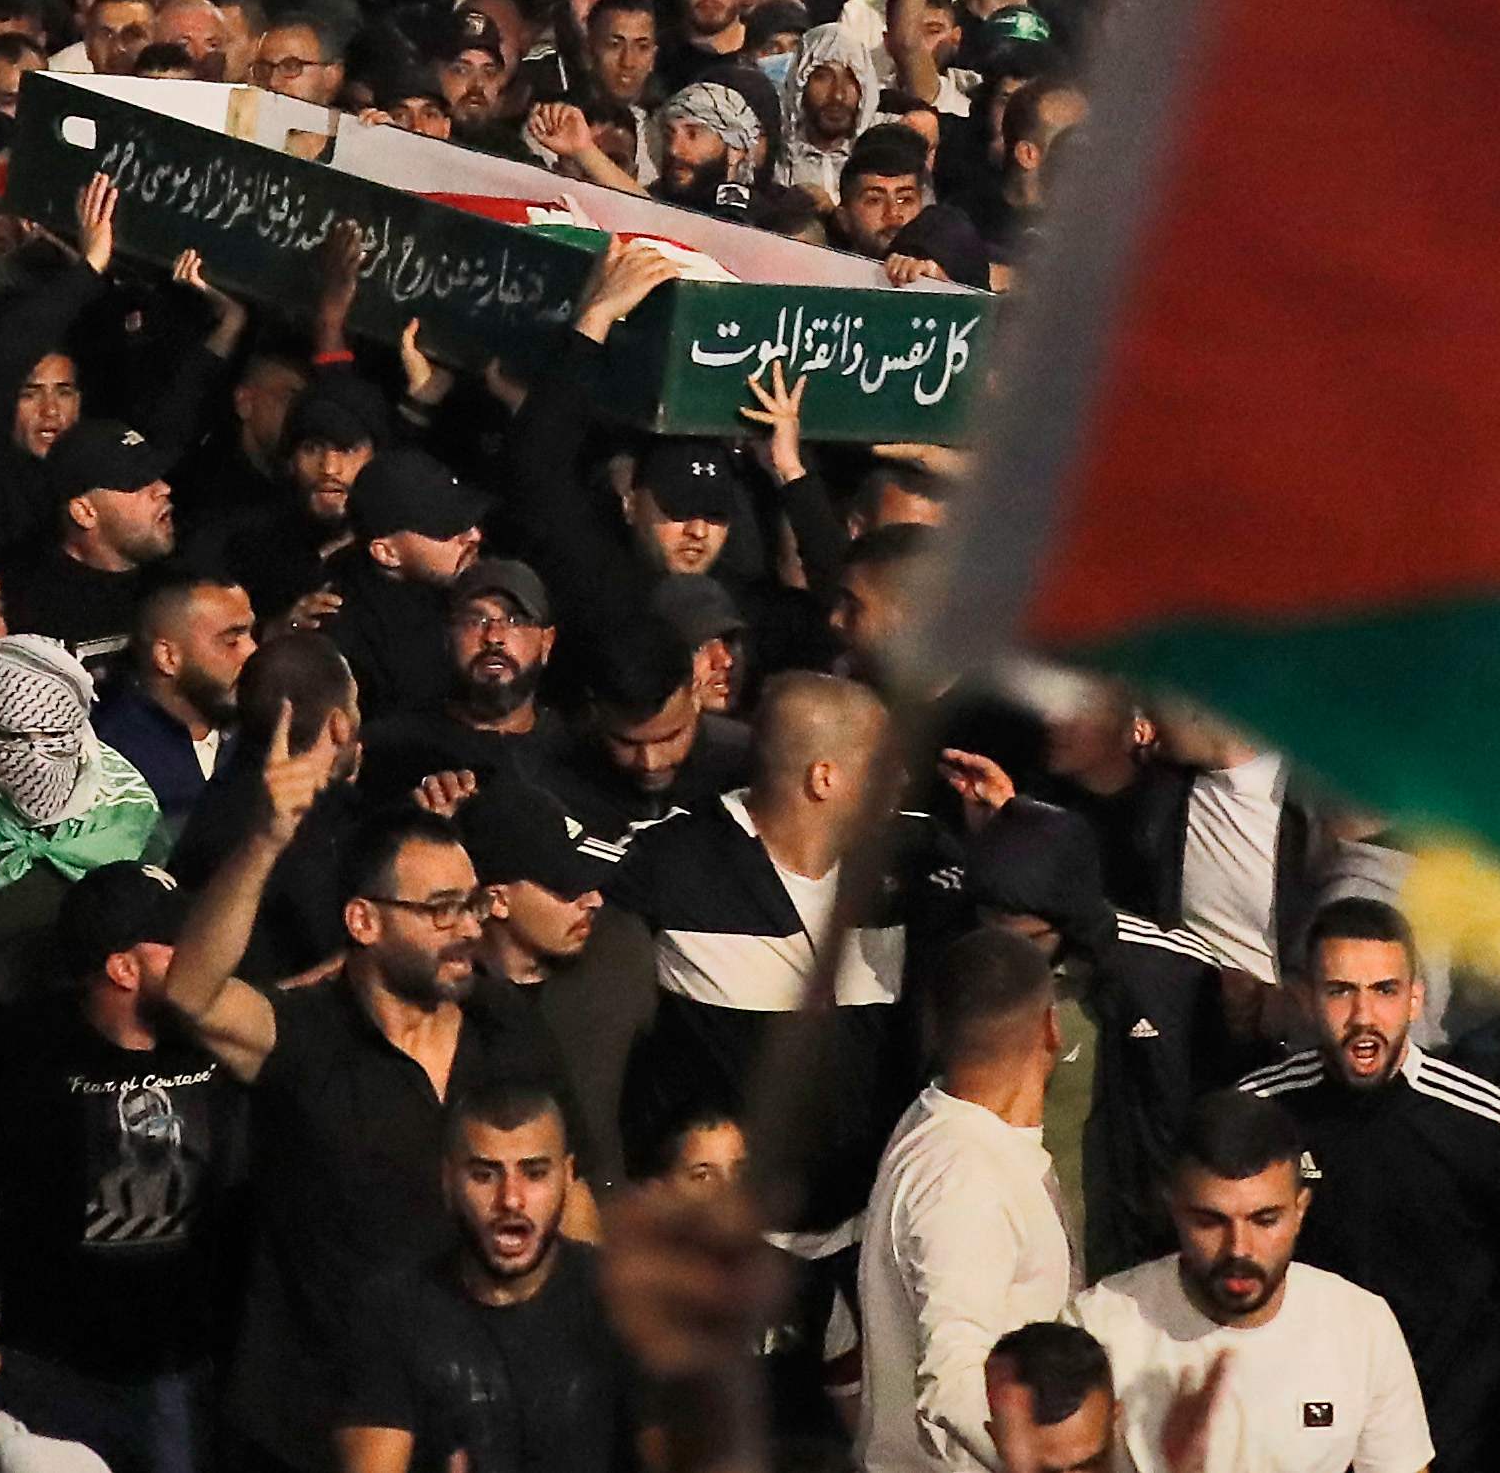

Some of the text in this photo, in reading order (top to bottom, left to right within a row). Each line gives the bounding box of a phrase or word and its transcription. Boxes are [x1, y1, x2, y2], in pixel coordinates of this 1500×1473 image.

[691, 306, 981, 406] كل نفس ذائقة الموت
